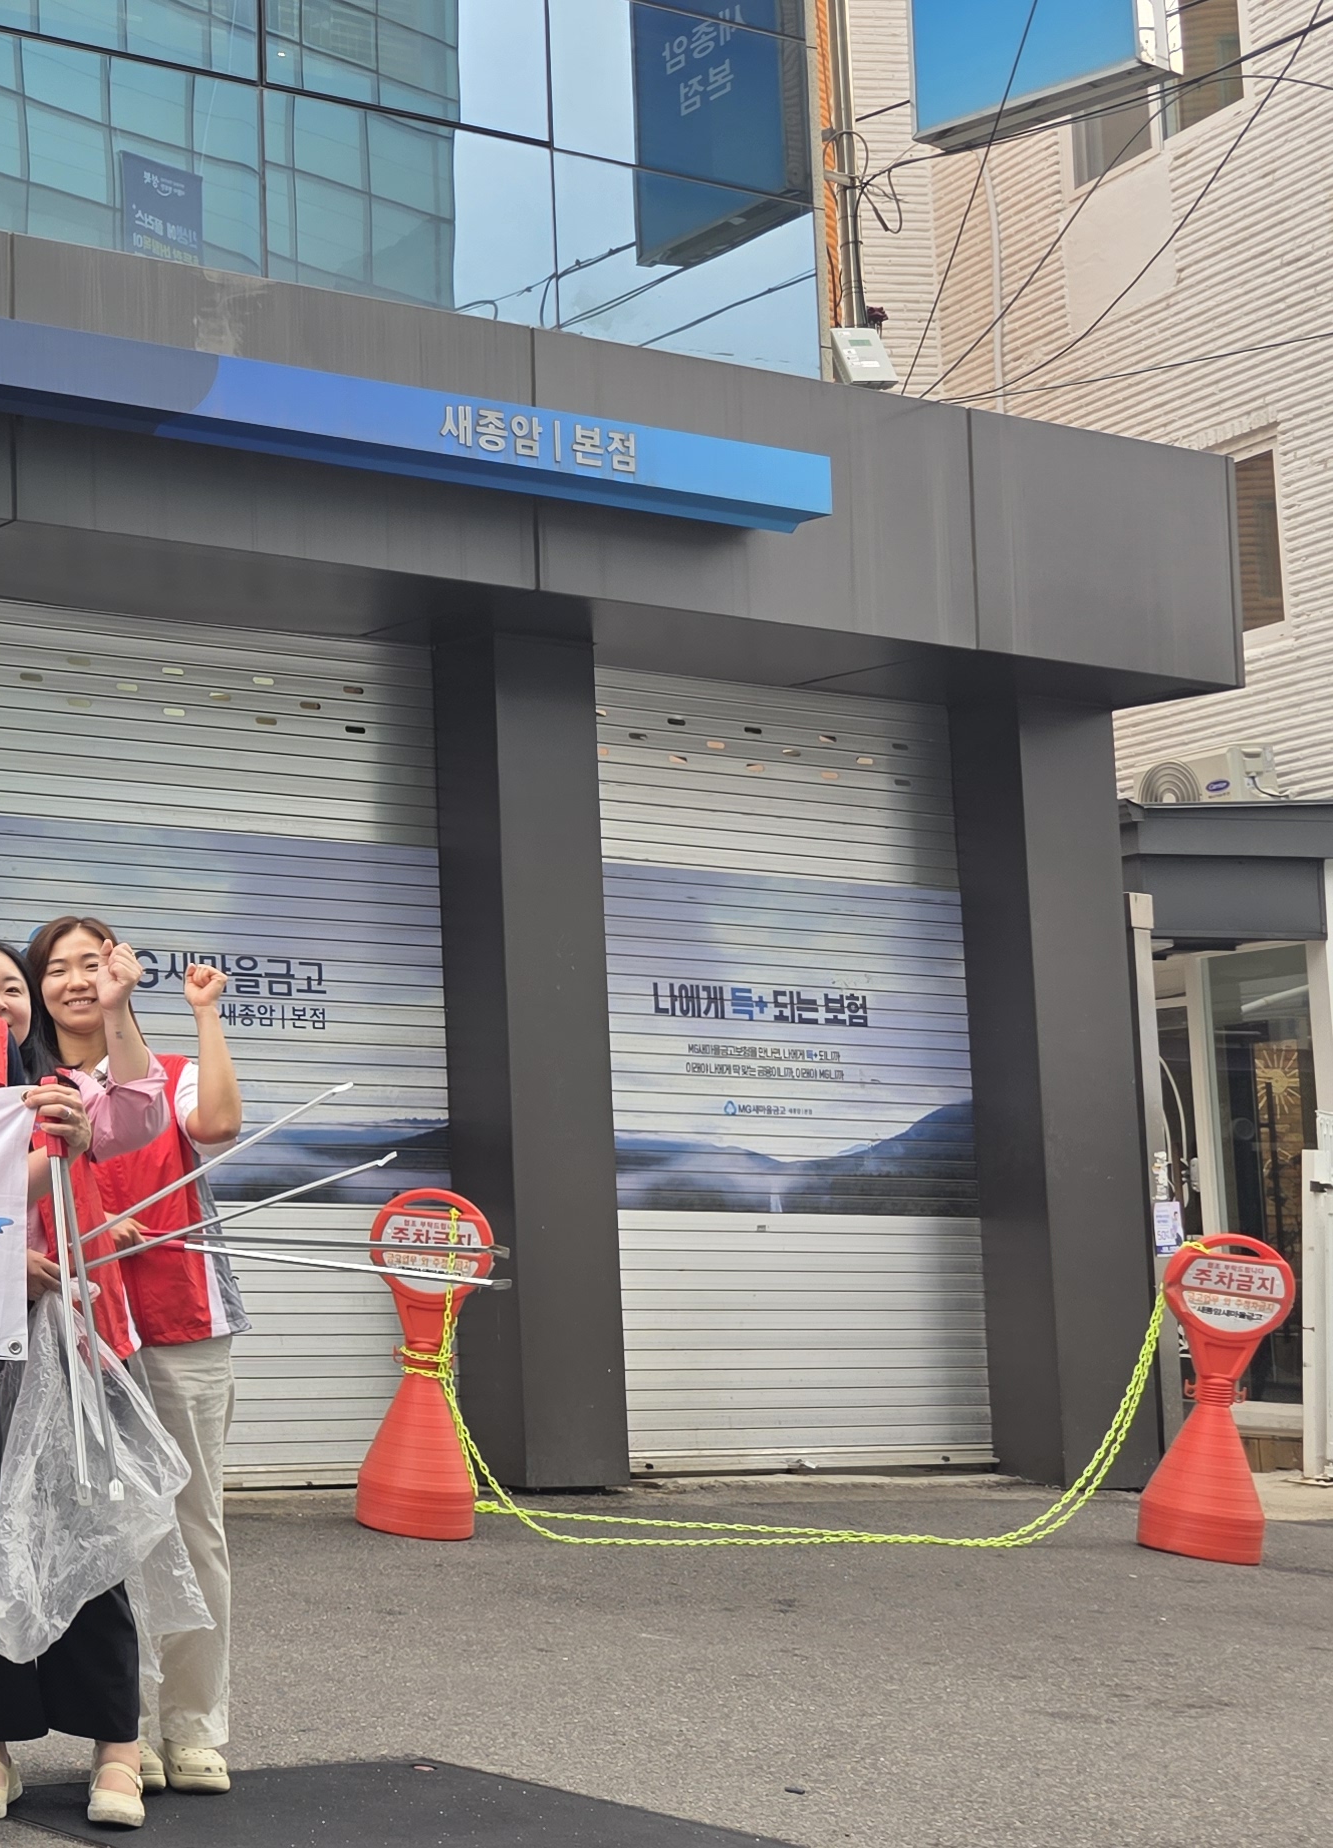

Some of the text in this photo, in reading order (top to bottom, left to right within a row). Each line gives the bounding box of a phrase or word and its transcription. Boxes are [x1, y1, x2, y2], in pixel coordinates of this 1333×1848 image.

[440, 405, 636, 473] 새종암 본점
[134, 951, 327, 997] G새을금고
[220, 1003, 326, 1030] 새종암 본점
[652, 982, 725, 1019] 나에게
[773, 989, 819, 1025] 되는
[823, 993, 868, 1027] 보험
[1192, 1268, 1275, 1295] 주차금지
